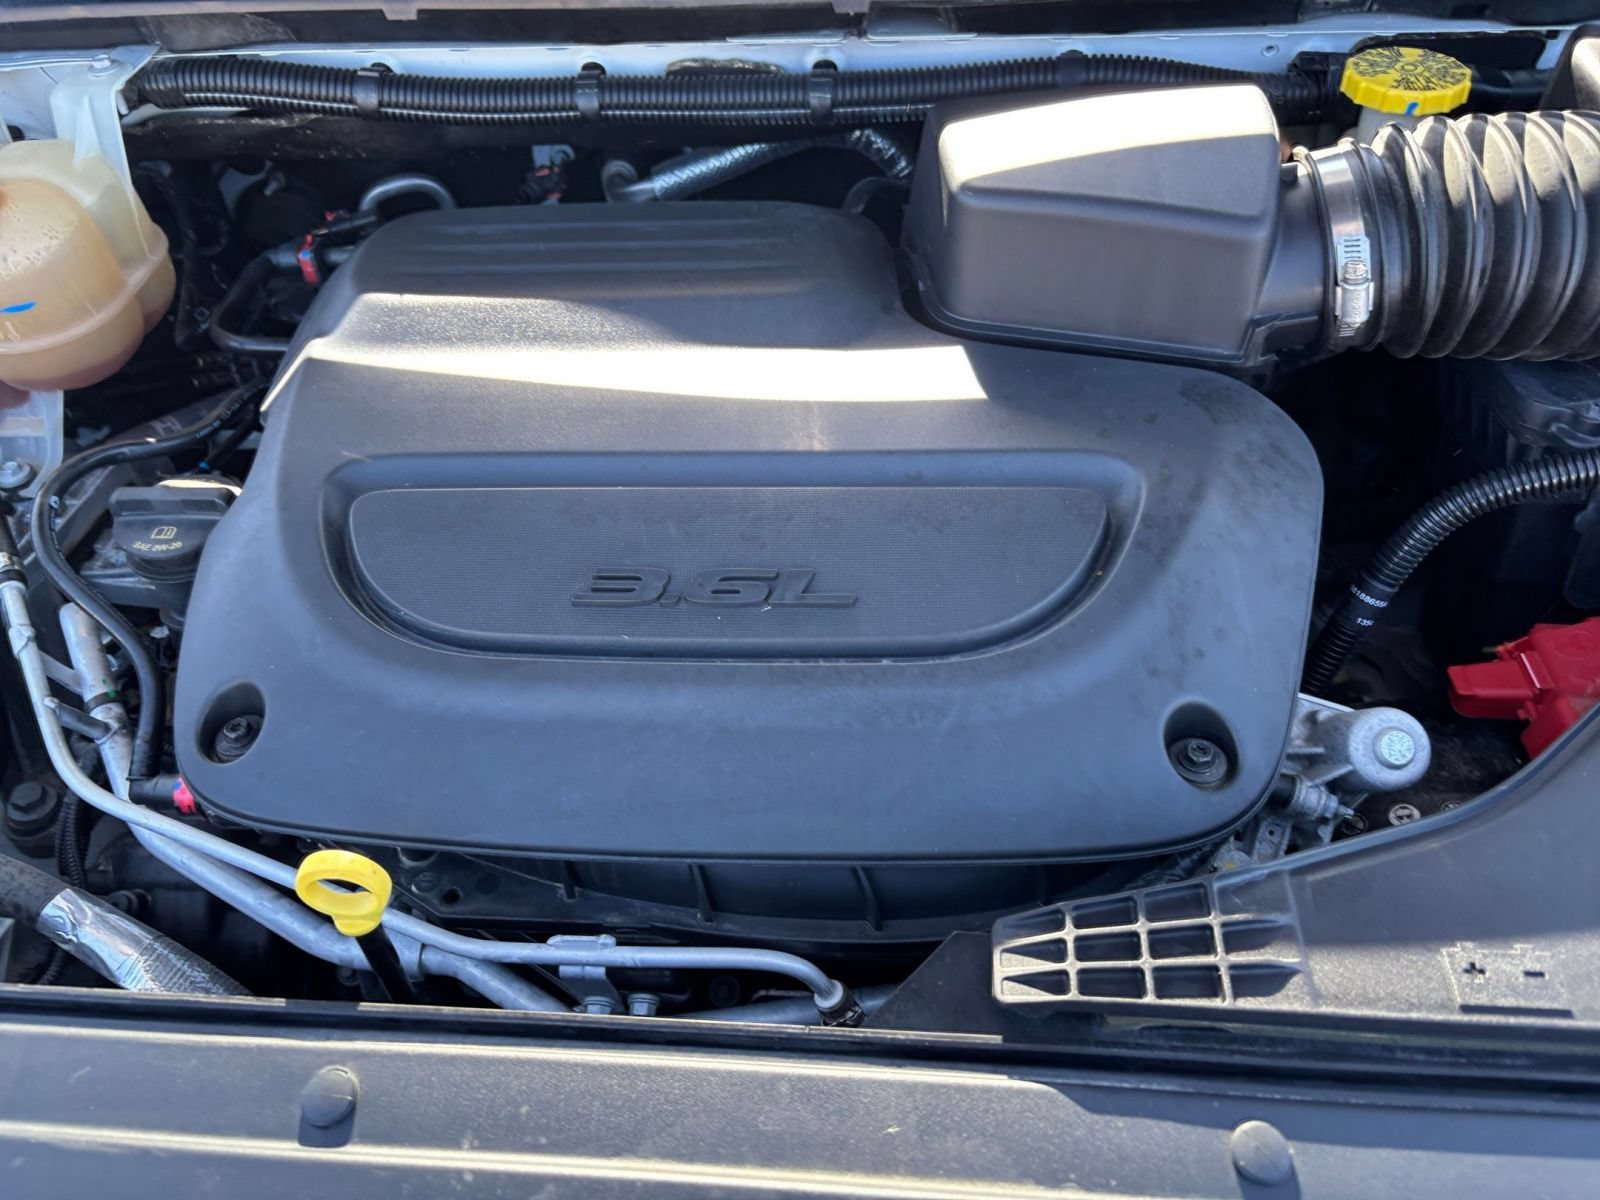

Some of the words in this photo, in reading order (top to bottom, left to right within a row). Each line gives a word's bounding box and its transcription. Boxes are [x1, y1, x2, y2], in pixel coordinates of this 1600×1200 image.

[131, 541, 152, 551] SAE
[151, 541, 183, 551] 0W-20
[571, 566, 858, 607] 3.6L
